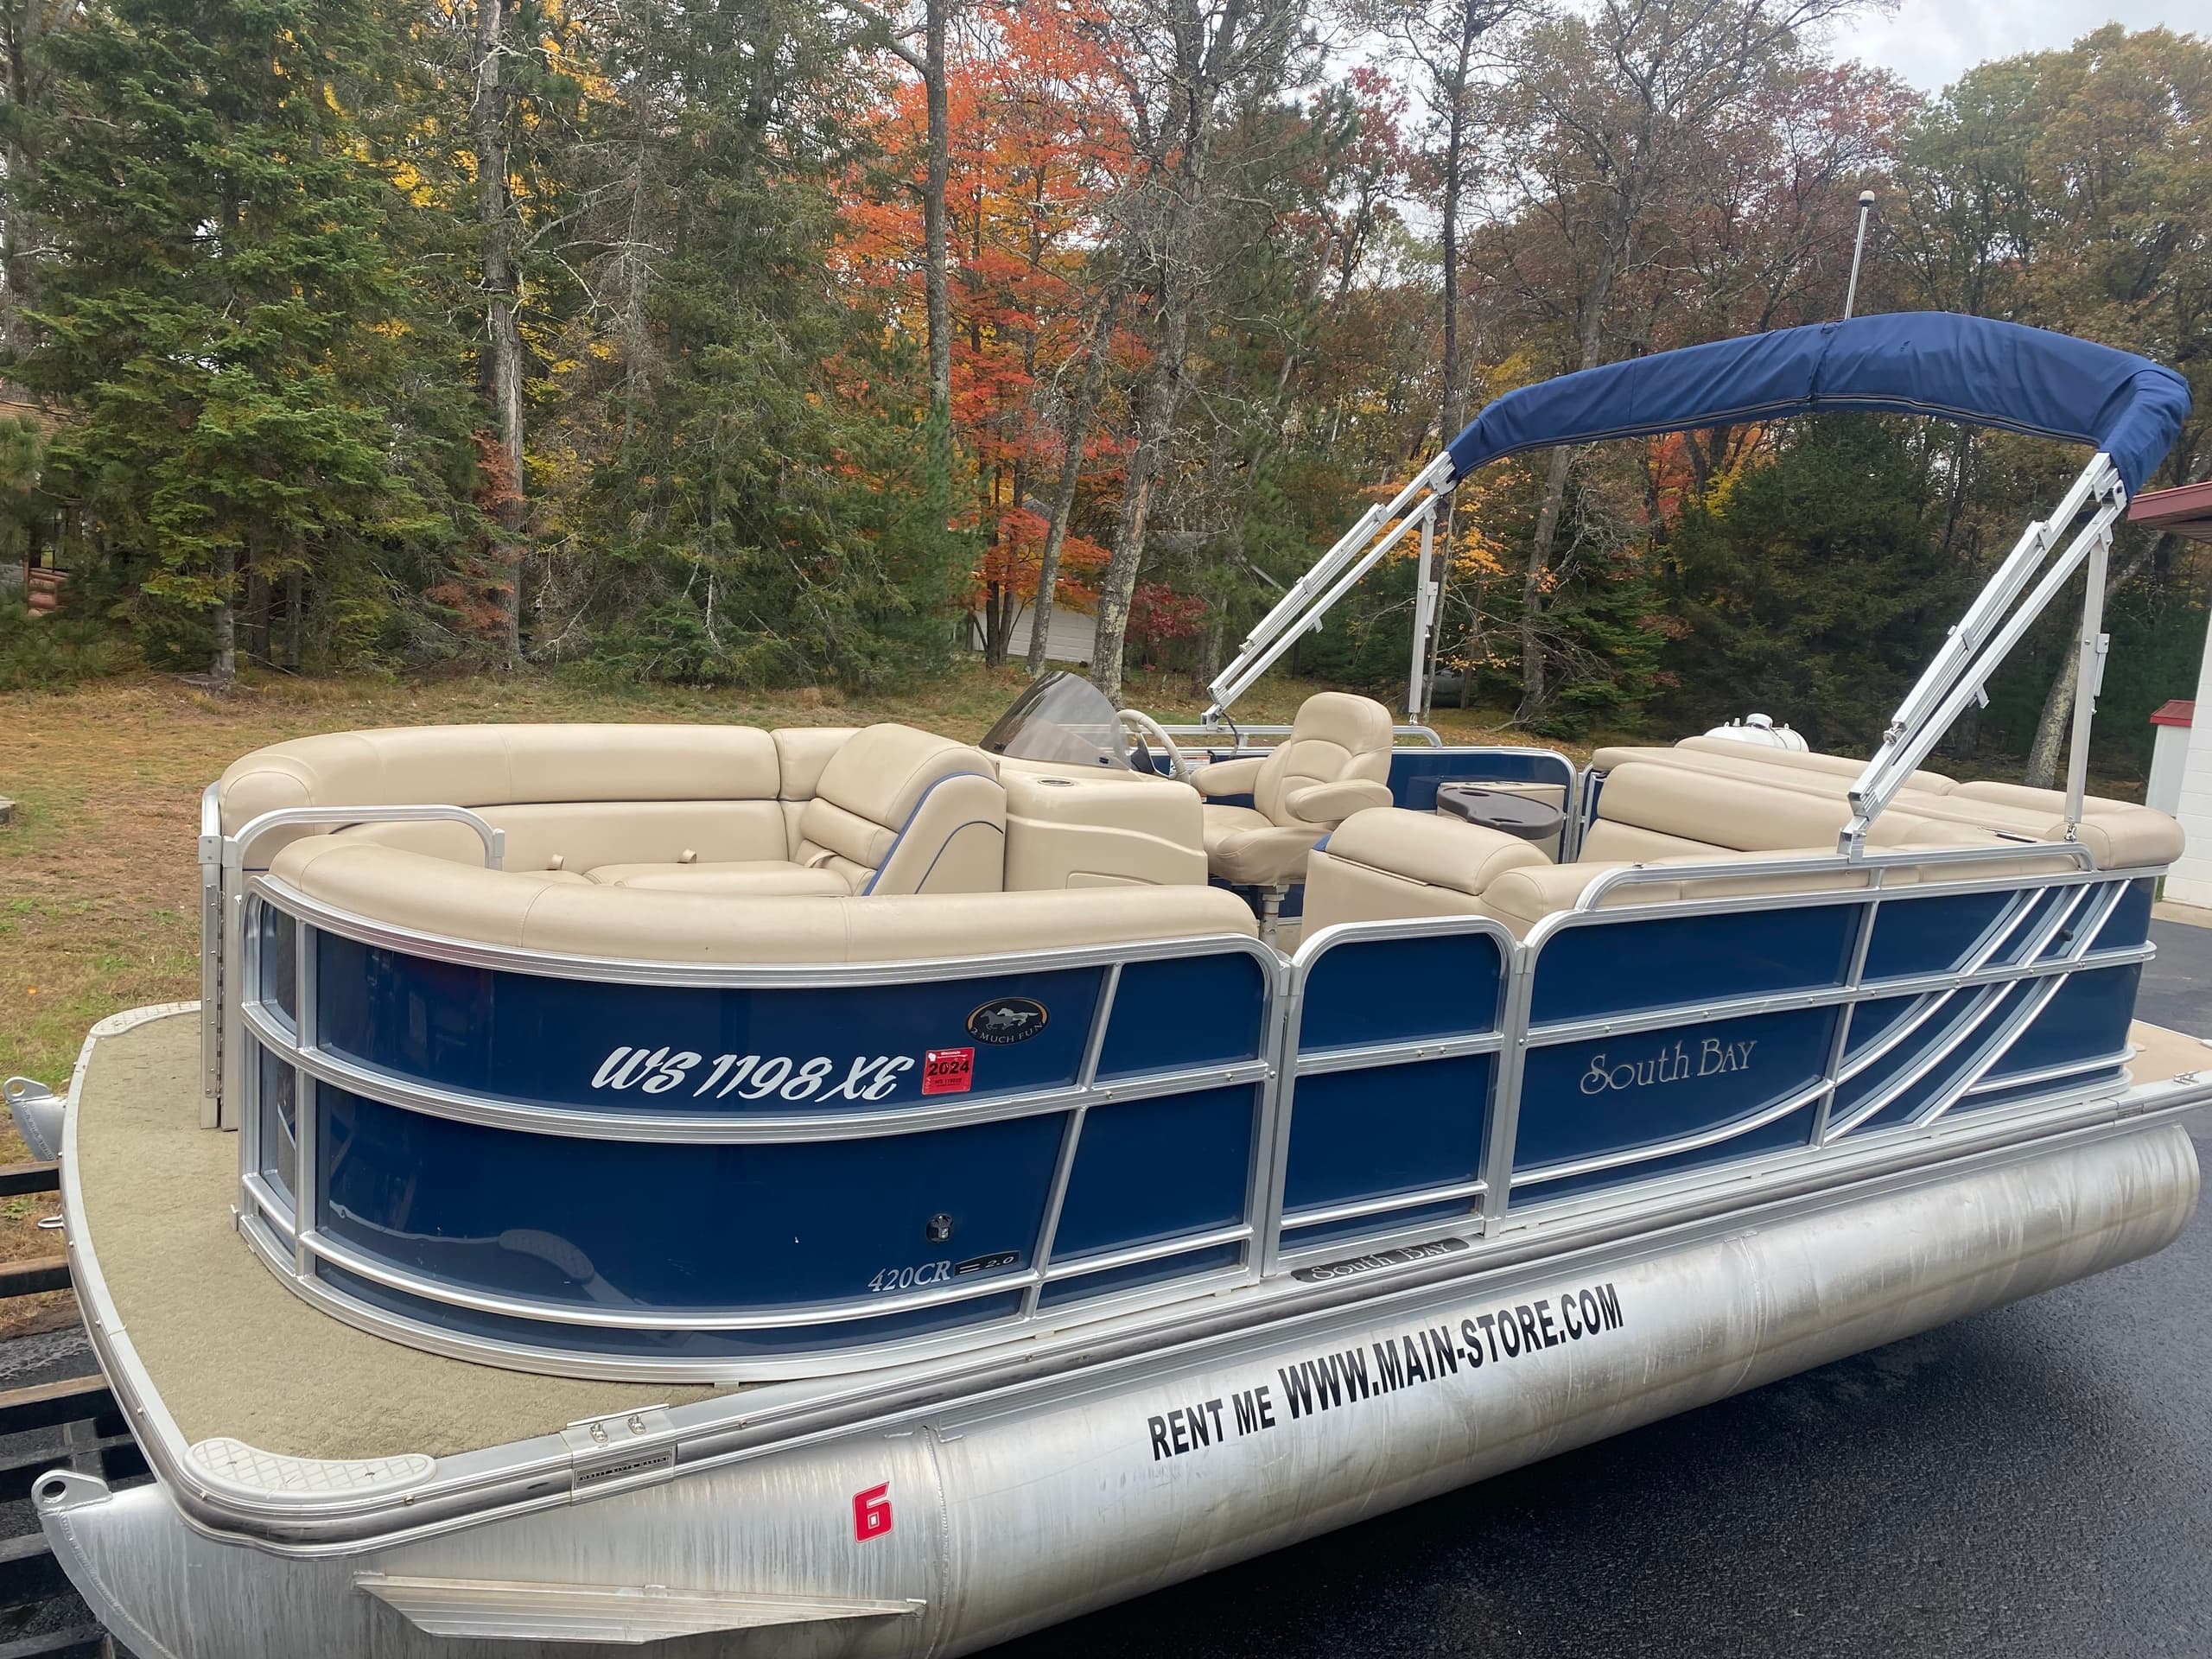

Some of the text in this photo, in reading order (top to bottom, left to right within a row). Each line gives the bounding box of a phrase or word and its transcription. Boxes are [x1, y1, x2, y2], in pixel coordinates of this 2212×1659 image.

[980, 1032, 1014, 1043] MUCH
[1019, 1021, 1043, 1038] FUN
[591, 1046, 915, 1103] WS 1198 XE
[928, 1060, 969, 1076] 2024
[1580, 1038, 1758, 1095] South BAY
[868, 1261, 950, 1293] 420CR
[985, 1256, 1014, 1268] 2.0
[1312, 1242, 1451, 1280] South BAY
[1147, 1283, 1624, 1460] RENT ME WWW.MAIN-STORE.COM
[852, 1481, 893, 1544] 6
